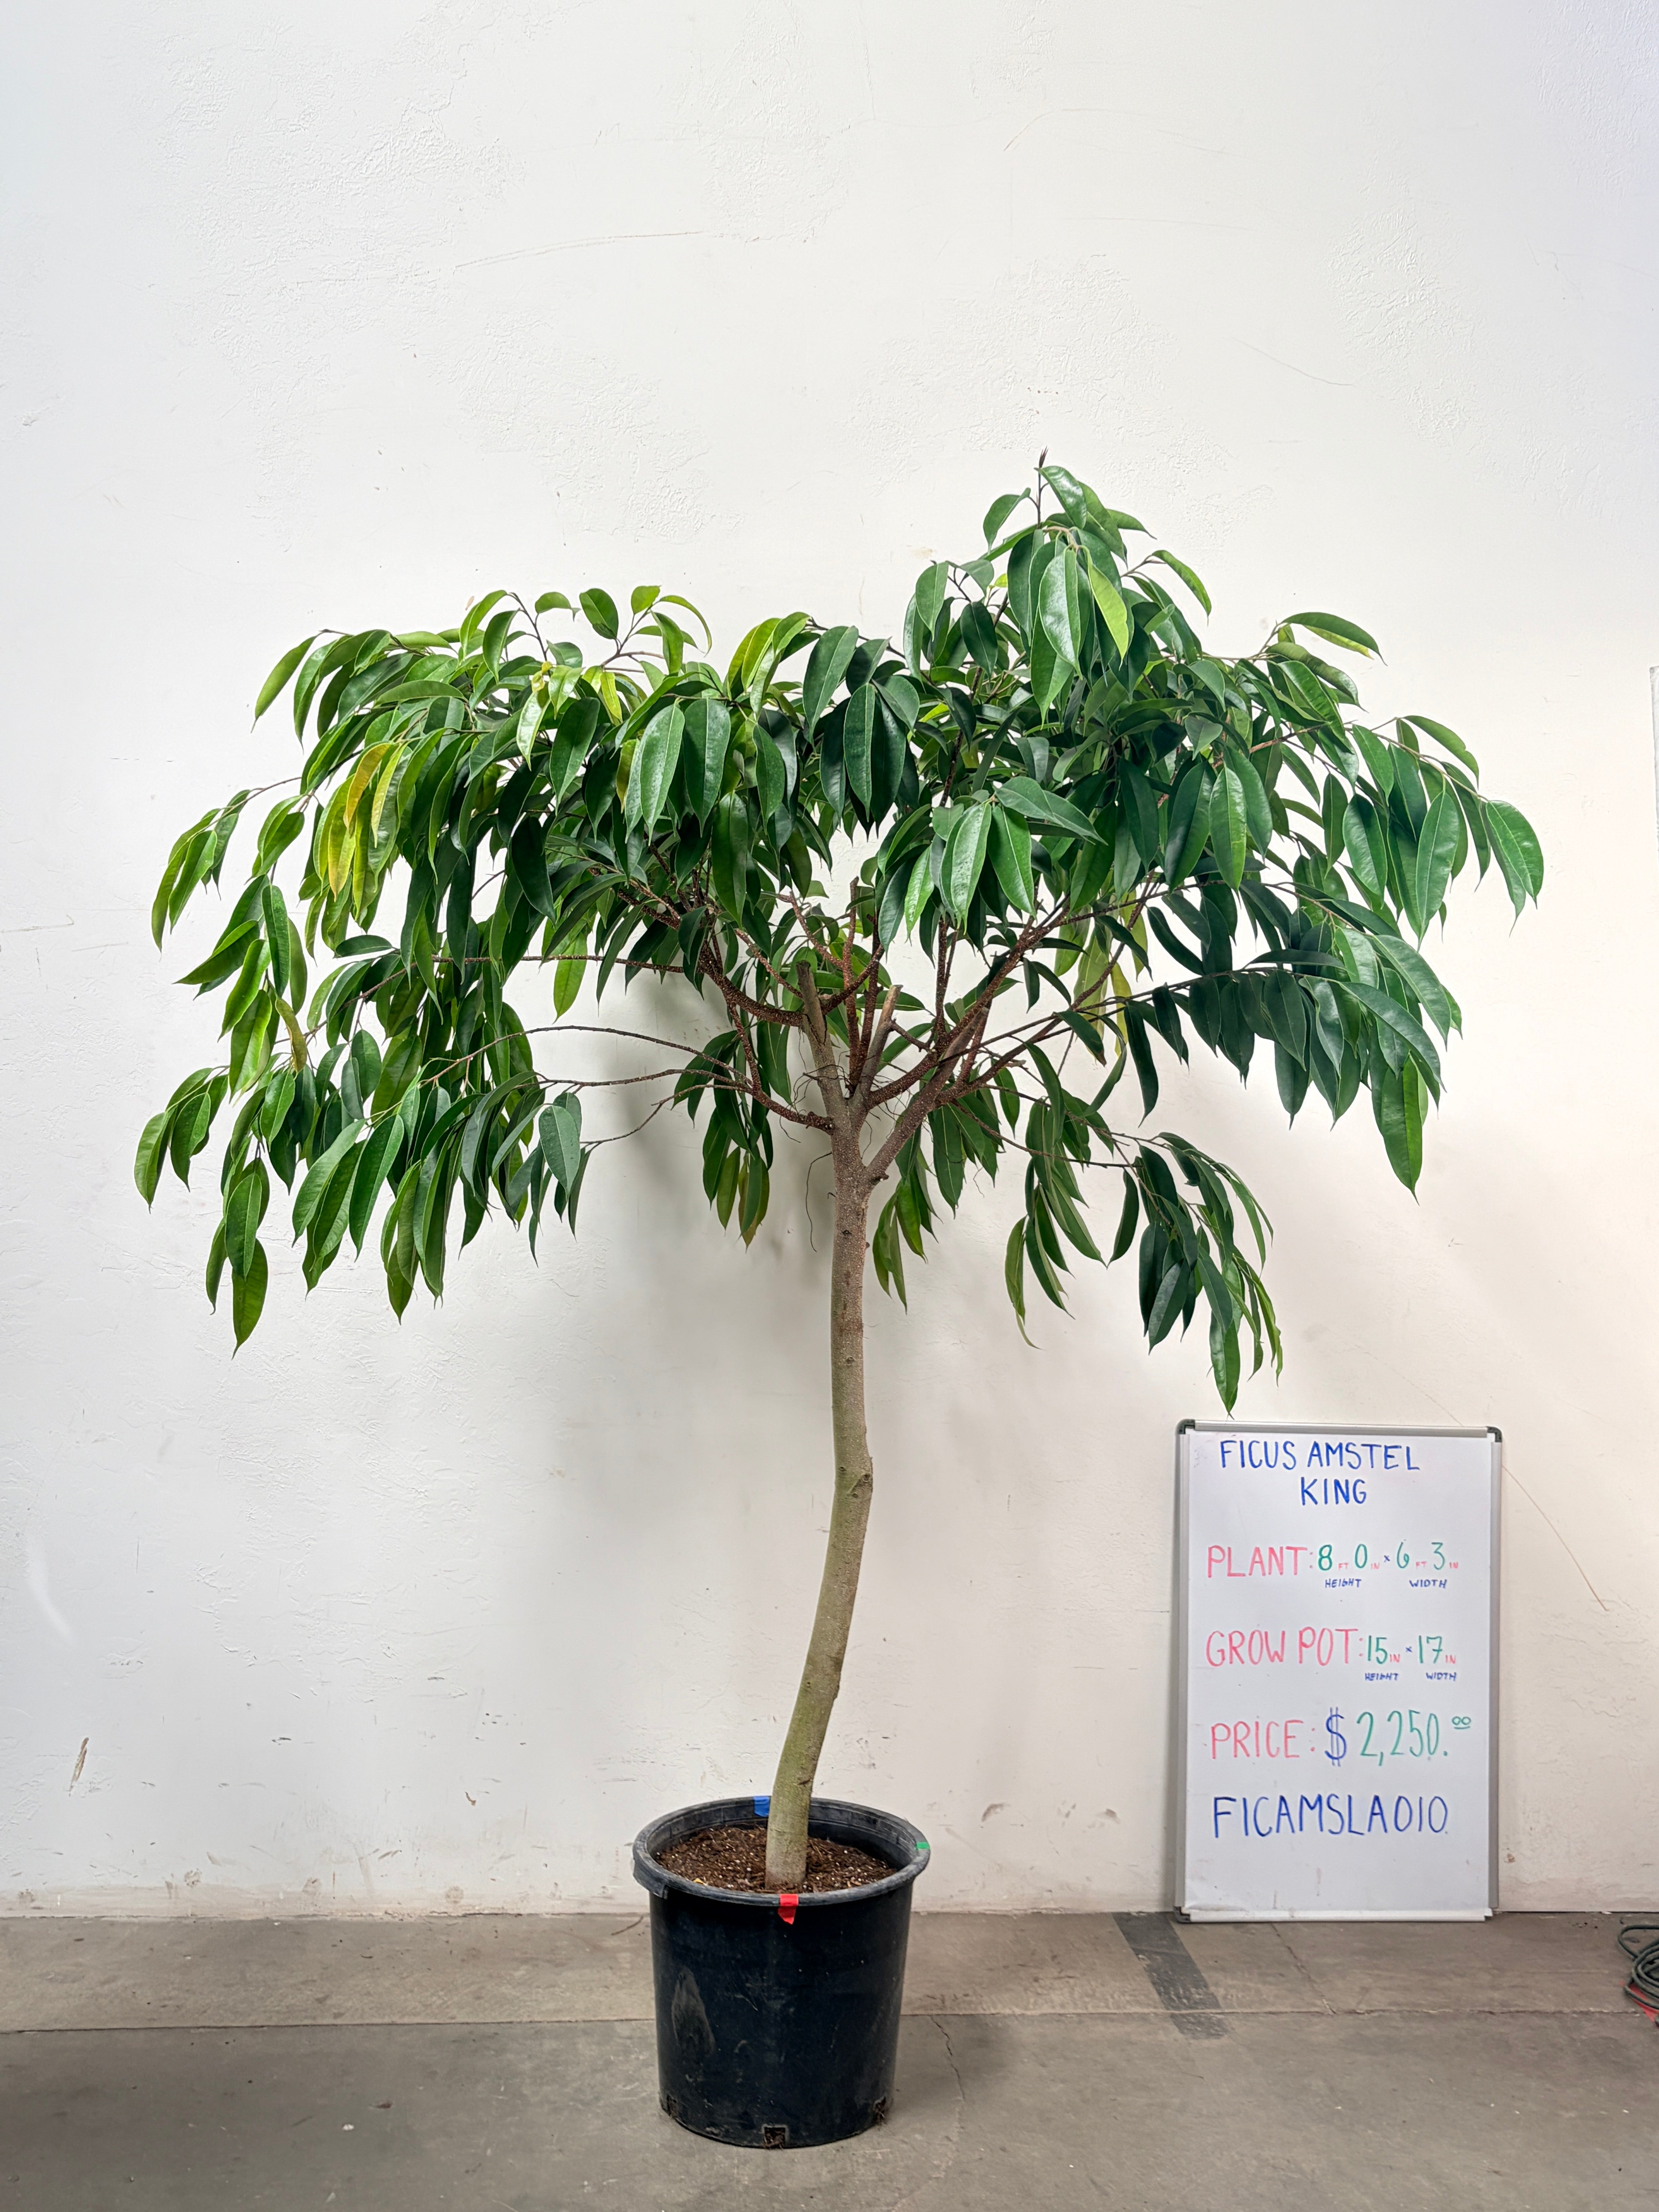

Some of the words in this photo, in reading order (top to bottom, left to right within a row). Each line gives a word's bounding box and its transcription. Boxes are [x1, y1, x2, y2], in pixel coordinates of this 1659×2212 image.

[1220, 1440, 1296, 1470] FICUS
[1307, 1442, 1419, 1470] AMSTEL
[1301, 1477, 1366, 1506] KING
[1207, 1545, 1313, 1578] PLANT:
[1318, 1545, 1333, 1571] 8
[1325, 1578, 1362, 1588] HEIGHT
[1409, 1578, 1448, 1589] WIDTH
[1206, 1630, 1285, 1667] GROW
[1298, 1627, 1363, 1666] POT:
[1365, 1673, 1399, 1681] HEIGHT
[1426, 1672, 1456, 1681] WIDTH
[1211, 1720, 1314, 1759] PRICE:
